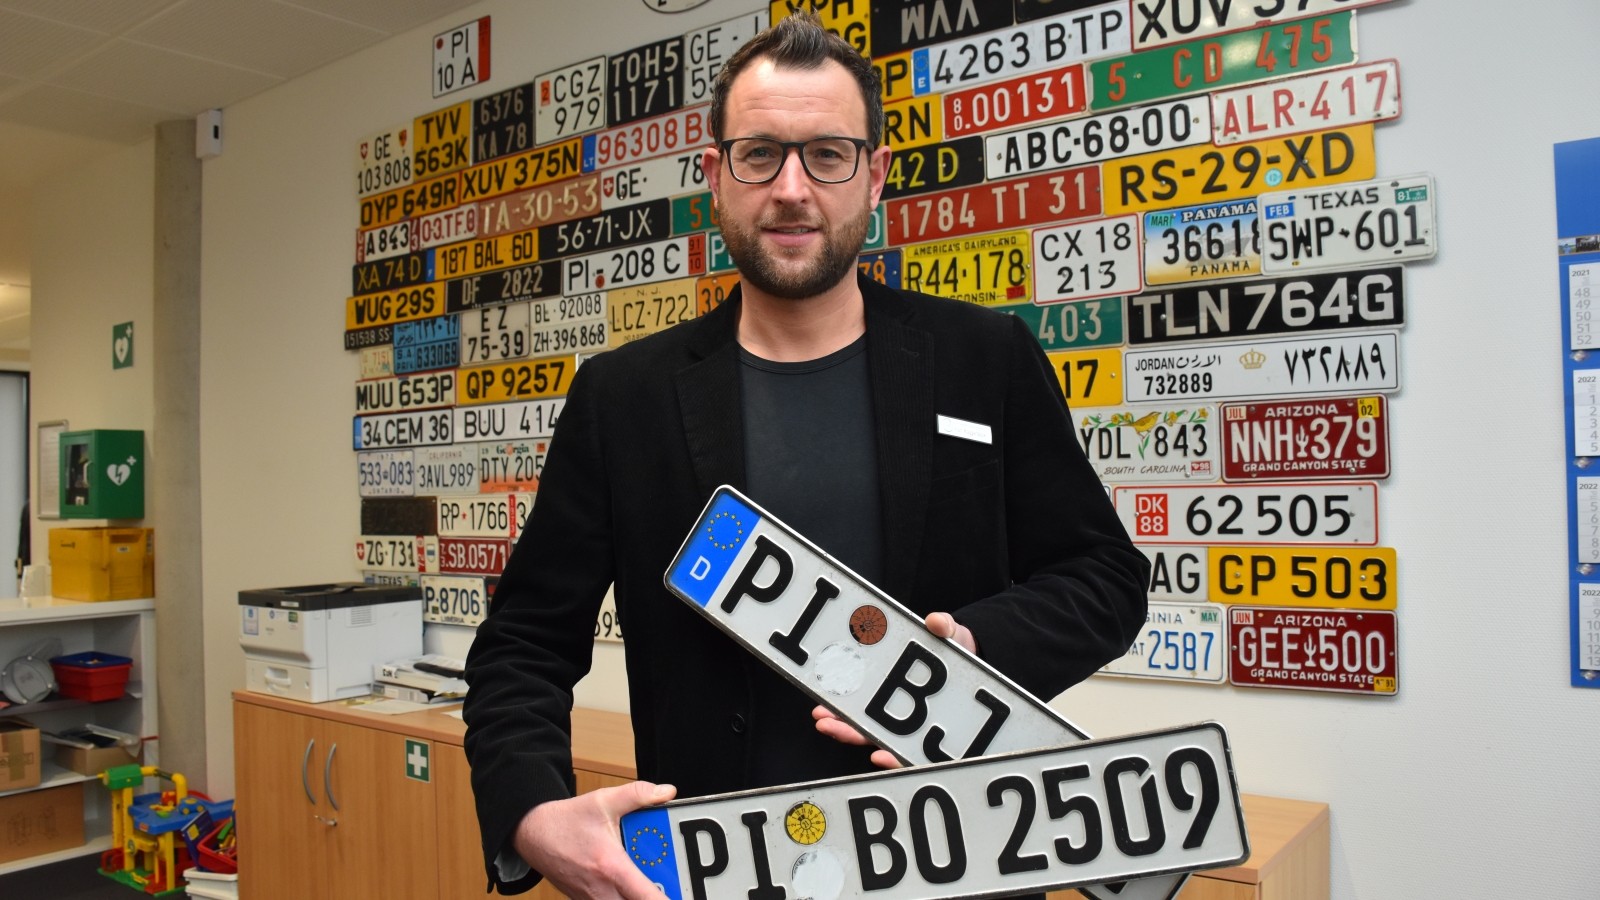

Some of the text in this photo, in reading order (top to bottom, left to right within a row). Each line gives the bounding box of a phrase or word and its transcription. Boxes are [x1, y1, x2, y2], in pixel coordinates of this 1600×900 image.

[452, 28, 468, 58] PI
[934, 10, 1123, 84] 4263 BTP
[437, 57, 475, 91] 10 A
[1108, 61, 1126, 102] 5
[1256, 20, 1331, 73] 475
[554, 64, 600, 103] CGZ
[614, 76, 675, 121] 1171
[918, 77, 926, 88] E
[481, 88, 524, 125] 6376
[554, 98, 599, 135] 979
[422, 108, 461, 144] TVV
[478, 122, 526, 161] KA 78
[597, 117, 678, 164] 96308
[374, 133, 391, 161] GE
[415, 136, 467, 176] 563K
[584, 157, 595, 168] LT
[463, 142, 578, 200] XUV 375N
[938, 147, 959, 183] D
[1120, 132, 1354, 205] RS-29-XD
[402, 177, 457, 216] 649R
[900, 193, 975, 239] 1784
[992, 182, 1029, 224] TT
[1049, 172, 1086, 215] 31
[1182, 202, 1258, 223] PANAMA
[1269, 187, 1411, 217] FEB TEXAS 81
[914, 235, 1017, 256] AMERICA'S DAIRYLAND
[1040, 223, 1131, 262] CX 18
[1268, 205, 1426, 260] SWP 601
[441, 232, 533, 276] 187 BAL 60
[569, 243, 681, 291] PI 208 C
[1190, 262, 1250, 276] PANAMA
[357, 256, 421, 292] XA 74 D
[462, 265, 543, 306] DF 2822
[1057, 260, 1116, 294] 213
[355, 287, 435, 325] WUG 29S
[1133, 273, 1395, 338] TLN 764G
[1574, 288, 1591, 298] 48
[1575, 300, 1591, 310] 49
[1039, 301, 1102, 344] 403
[1576, 311, 1592, 322] 50
[1577, 323, 1591, 334] 51
[468, 330, 524, 361] 75-39
[1577, 334, 1592, 345] 52
[466, 361, 565, 399] QP 9257
[1135, 357, 1175, 371] JORDAN
[356, 375, 453, 411] MUU 653P
[1144, 372, 1213, 396] 732889
[464, 408, 505, 438] BUU
[1228, 404, 1373, 419] JUL ARIZONA 02
[363, 414, 449, 446] 34 CEM 36
[1080, 424, 1208, 460] YDL 843
[1230, 415, 1377, 463] NNH 379
[360, 461, 413, 486] 533 083
[419, 463, 474, 488] 3AVL989
[481, 456, 509, 483] DTY
[1104, 464, 1186, 475] SOUTH CAROLINA
[1243, 459, 1367, 472] GRAND CANYON STATE
[441, 503, 460, 530] RP
[469, 502, 508, 530] 1766
[1138, 497, 1165, 514] DK
[1140, 516, 1164, 533] 88
[378, 576, 402, 585] TEXAS
[690, 555, 711, 581] D
[1219, 554, 1387, 601] CP 503
[1201, 612, 1218, 622] MAY
[1235, 612, 1347, 628] JUN ARIZONA
[721, 534, 1011, 763] PI BJ
[1148, 630, 1215, 671] 2587
[1238, 627, 1385, 674] GEE 500
[1250, 669, 1288, 680] GRAND
[1290, 671, 1337, 682] CANYON
[1339, 674, 1374, 684] STATE
[679, 810, 787, 900] PI
[986, 747, 1220, 875] 2509
